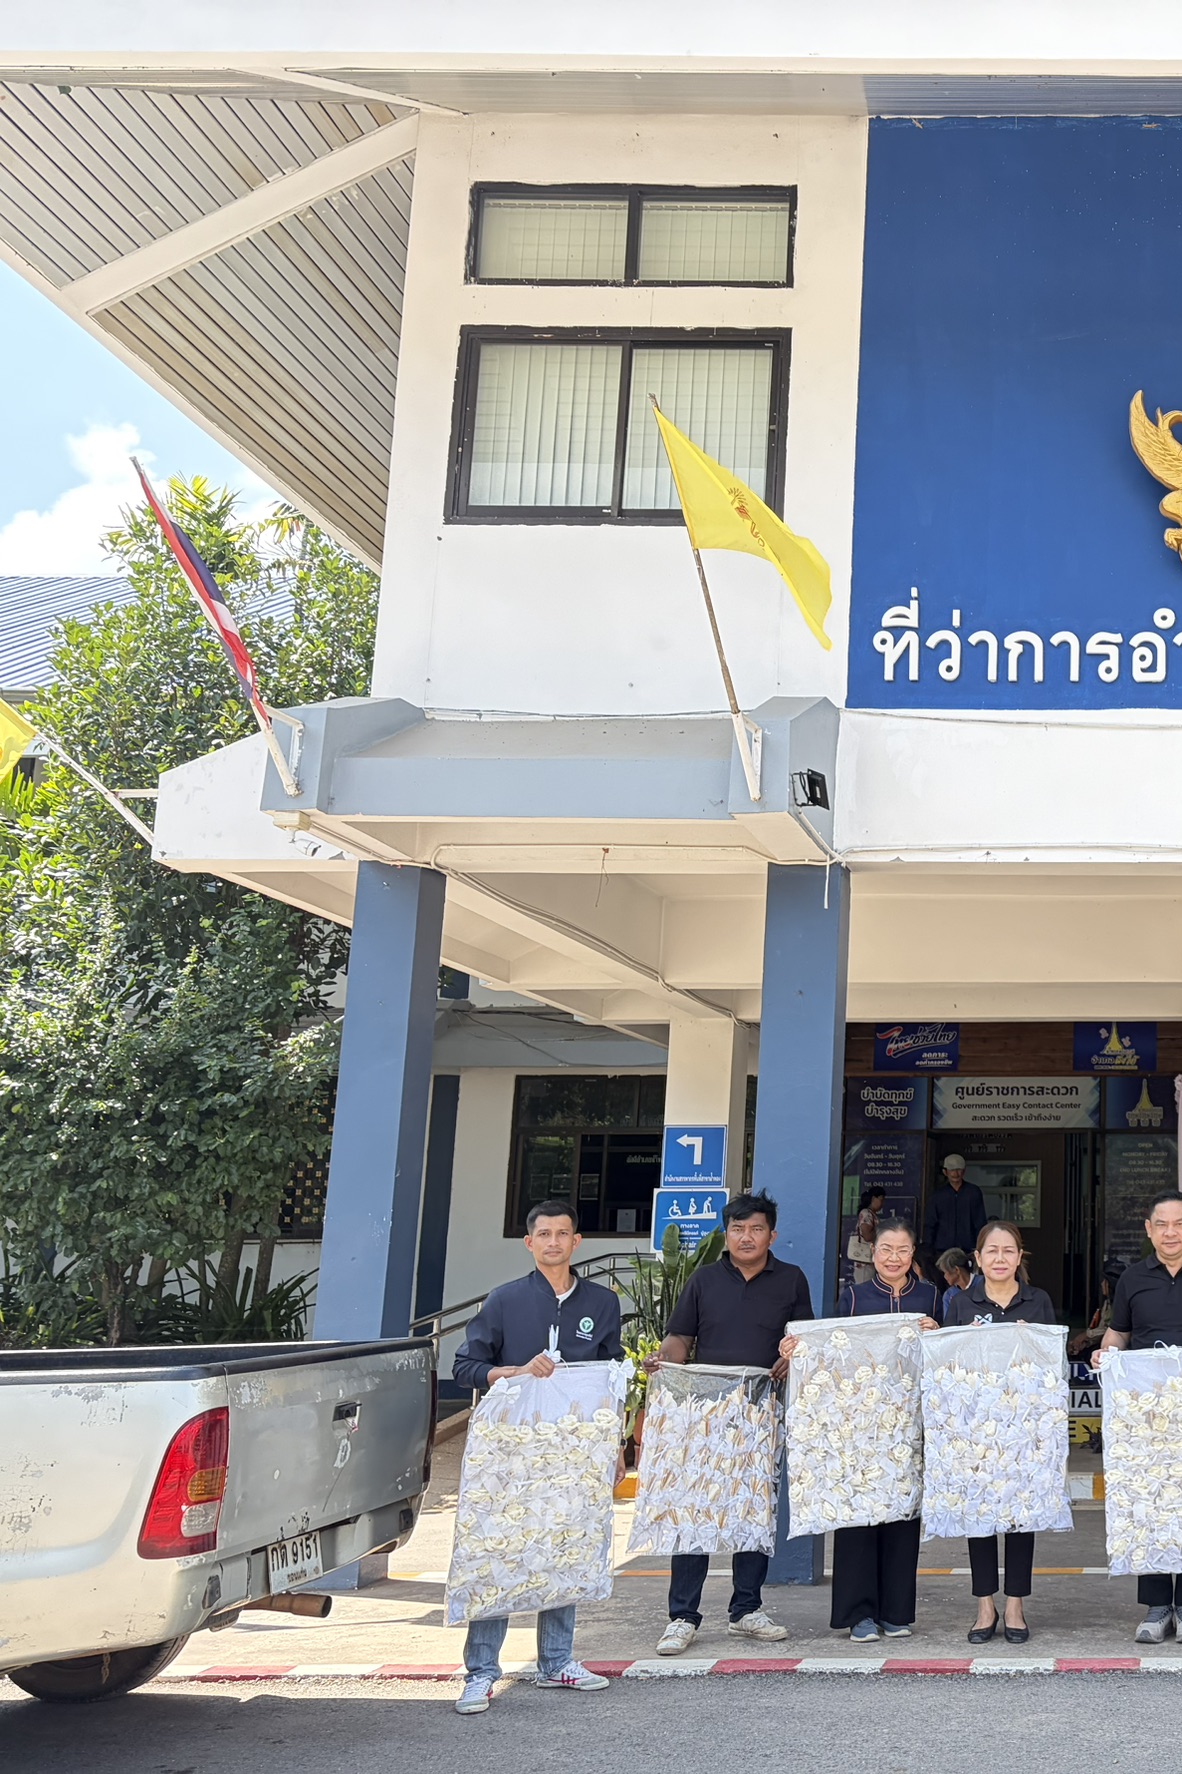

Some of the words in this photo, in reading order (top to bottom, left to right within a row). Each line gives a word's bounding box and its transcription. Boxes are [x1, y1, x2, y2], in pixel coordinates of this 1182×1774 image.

[861, 1086, 914, 1104] บำบัดทุกข์
[955, 1083, 1079, 1100] ศูนย์ราชการสะดวก
[865, 1103, 908, 1120] บำรุงสุข
[952, 1102, 1000, 1110] Government
[1002, 1102, 1021, 1110] Easy
[997, 1113, 1023, 1122] รวดเร็ว
[1024, 1113, 1061, 1122] เข้าถึงง่าย
[291, 1534, 318, 1565] 9151
